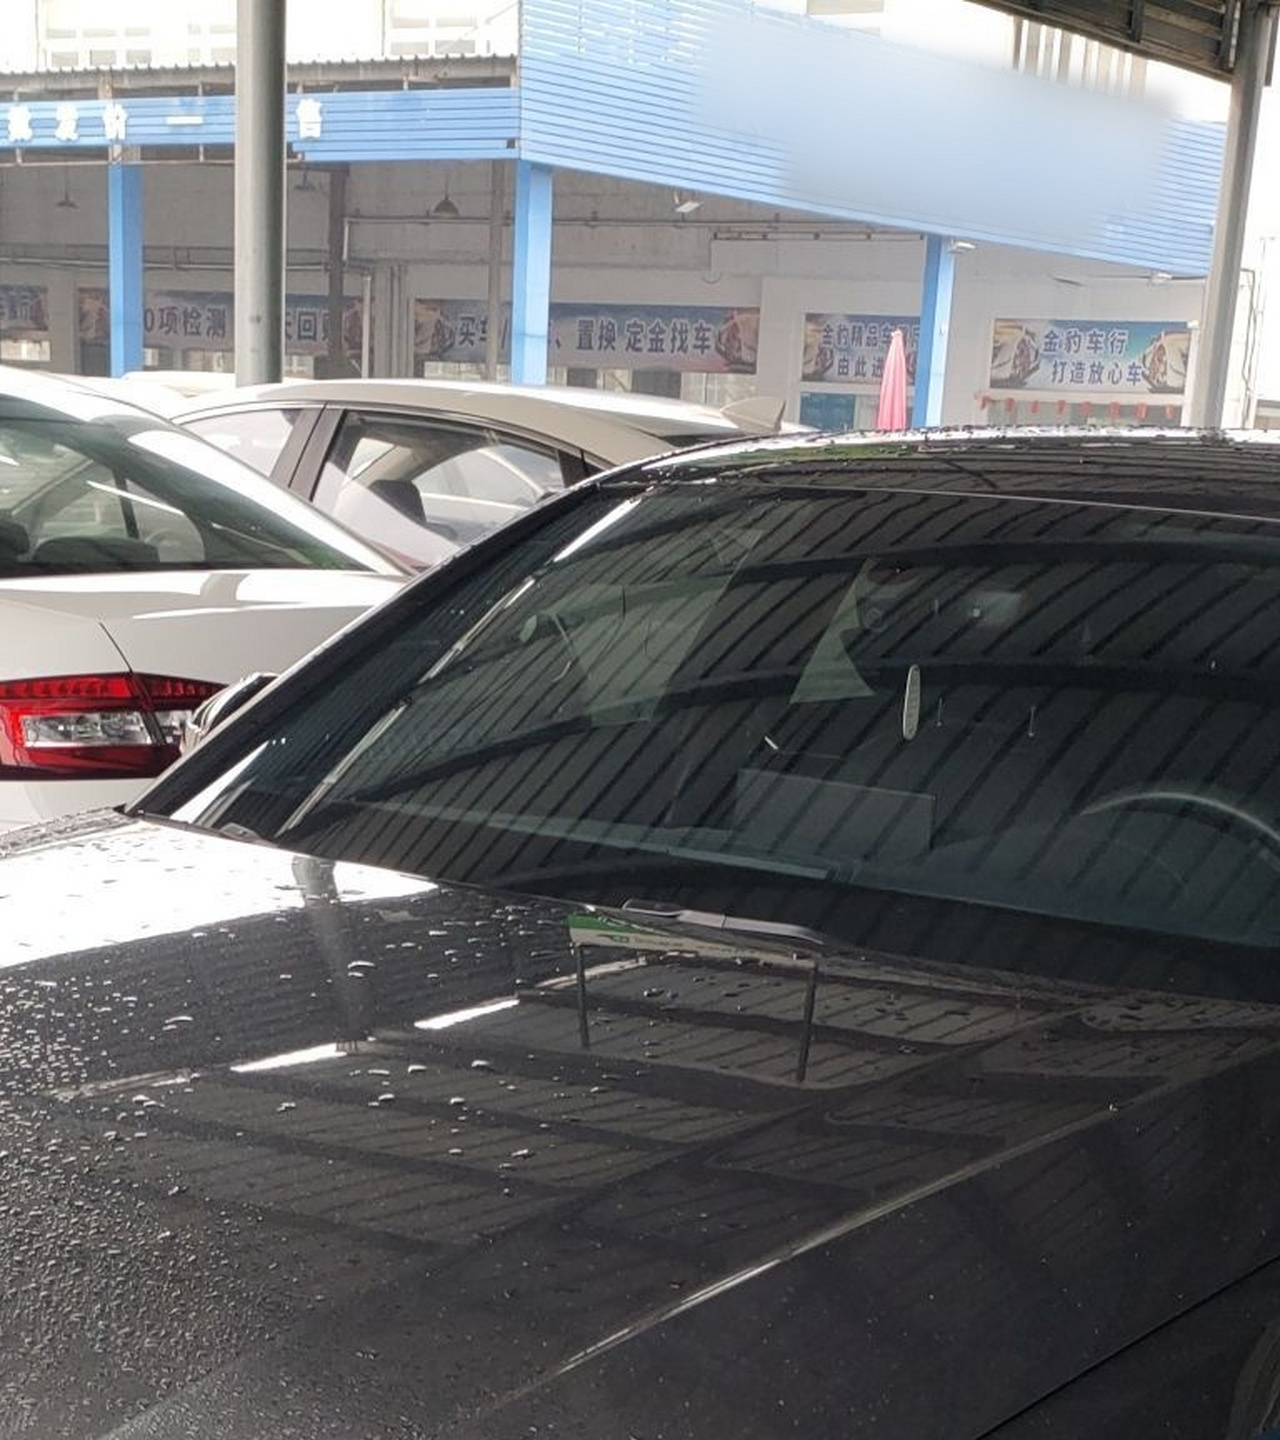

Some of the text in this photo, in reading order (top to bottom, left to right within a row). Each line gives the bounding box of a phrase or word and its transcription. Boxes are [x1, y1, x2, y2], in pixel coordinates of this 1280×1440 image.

[1043, 329, 1129, 355] 金豹车行
[1051, 360, 1143, 387] 打造放心车
